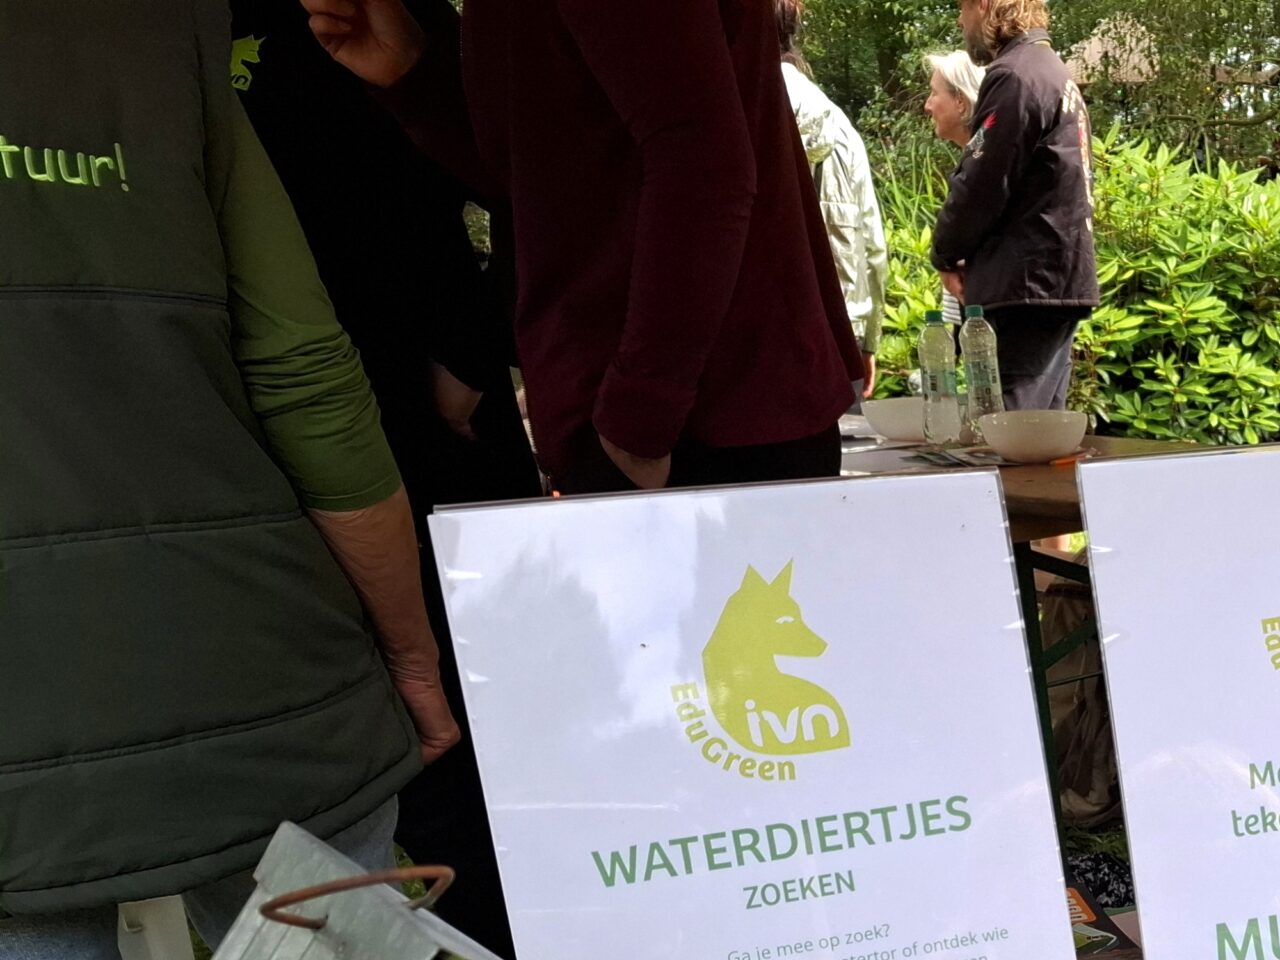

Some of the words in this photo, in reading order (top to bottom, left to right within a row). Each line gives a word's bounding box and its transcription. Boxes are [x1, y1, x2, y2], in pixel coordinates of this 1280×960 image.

[670, 682, 797, 782] EduGreen
[744, 698, 840, 748] ivn
[591, 795, 972, 888] WATERDIERTJES
[743, 869, 856, 910] ZOEKEN
[776, 939, 814, 958] mee
[818, 934, 841, 951] op
[845, 923, 891, 945] zoek?
[902, 941, 919, 958] of
[923, 931, 979, 954] ontdek
[981, 927, 1009, 942] wie
